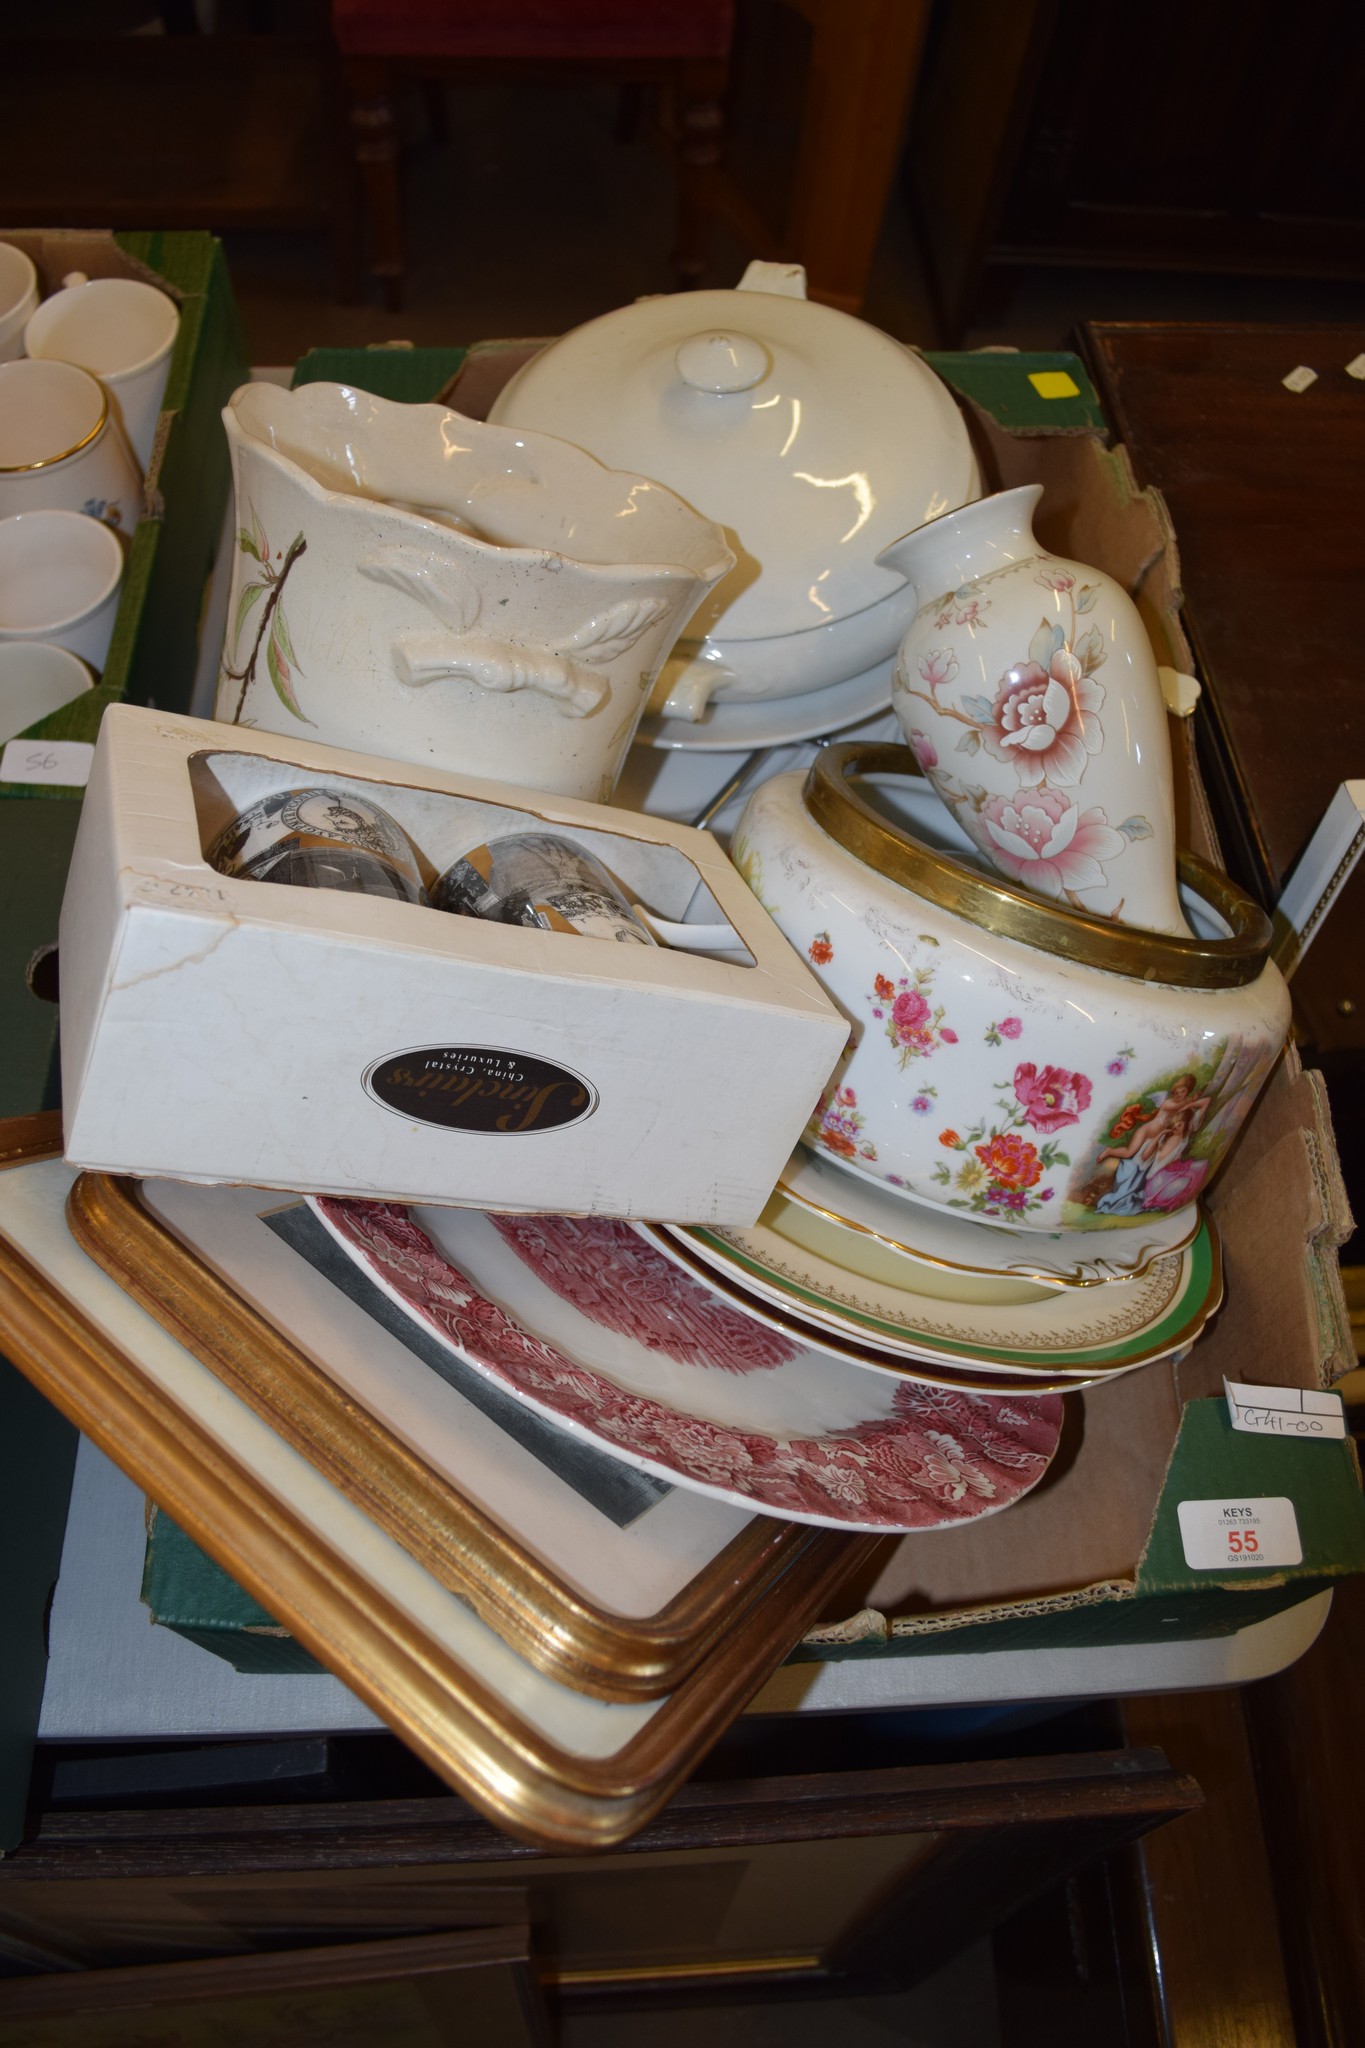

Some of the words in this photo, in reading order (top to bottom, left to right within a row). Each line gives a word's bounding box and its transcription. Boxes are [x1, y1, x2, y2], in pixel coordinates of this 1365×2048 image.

[443, 1051, 501, 1068] Luxuries
[508, 1060, 516, 1069] &
[425, 1060, 475, 1075] Crystal
[483, 1067, 524, 1082] China,
[387, 1066, 586, 1132] Sinclairs
[1223, 1507, 1253, 1518] KEYS
[1228, 1530, 1259, 1553] 55
[1227, 1553, 1264, 1562] GS191020
